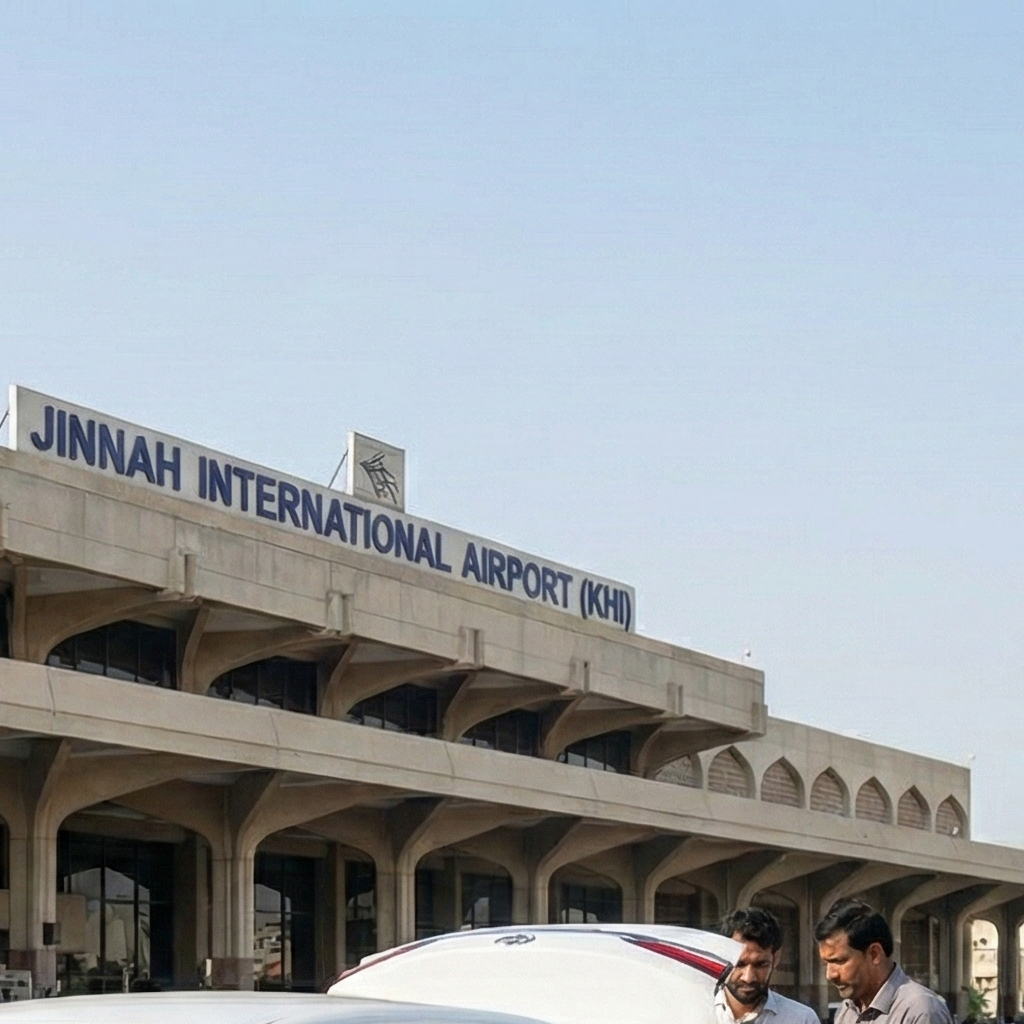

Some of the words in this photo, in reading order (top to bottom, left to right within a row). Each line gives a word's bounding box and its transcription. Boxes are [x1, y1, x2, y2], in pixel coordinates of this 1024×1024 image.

[30, 404, 182, 492] JINNAH
[198, 455, 453, 574] INTERNATIONAL
[461, 541, 573, 609] AIRPORT
[580, 577, 632, 634] (KHI)
